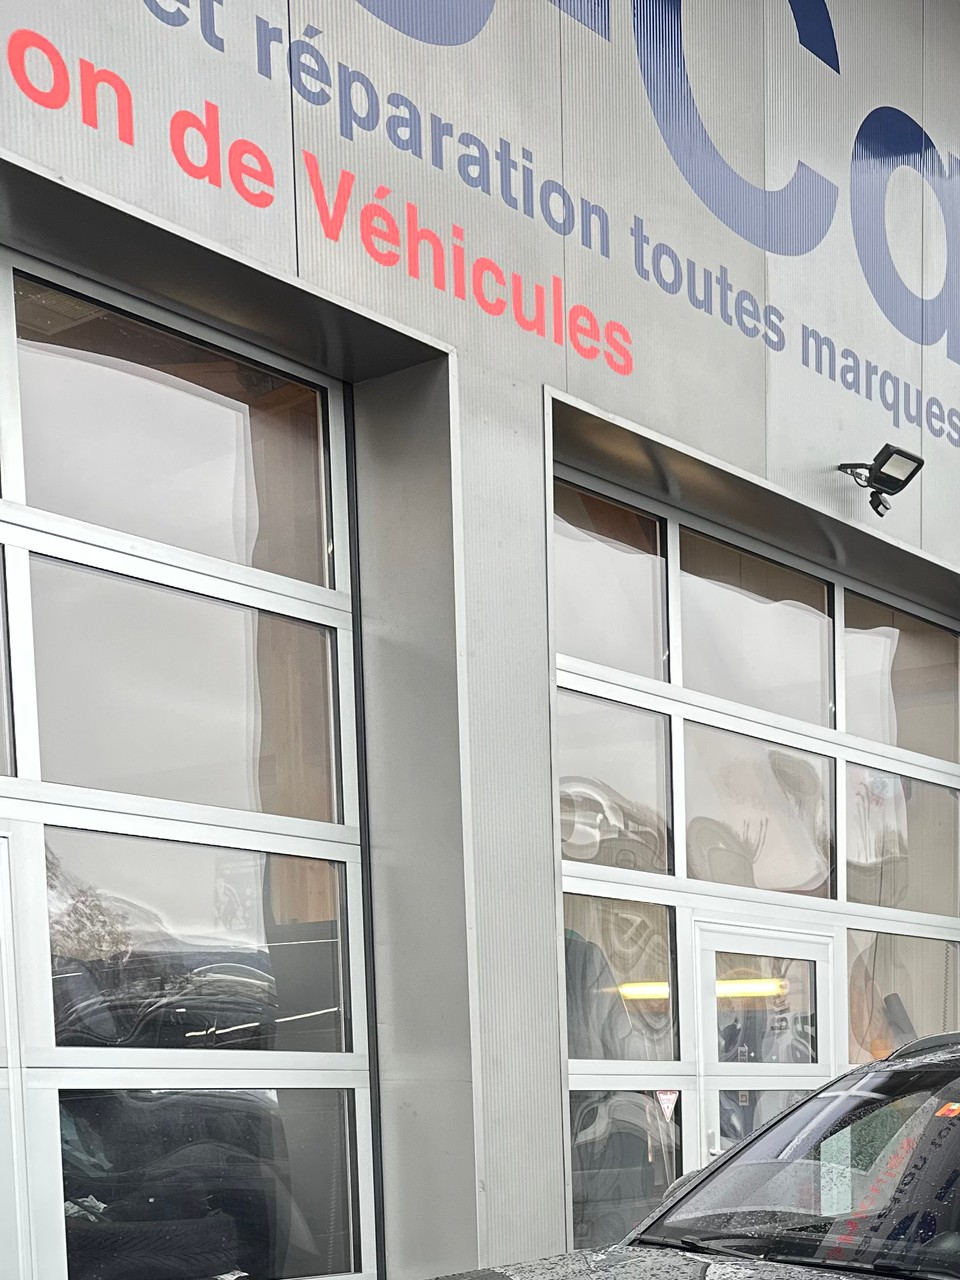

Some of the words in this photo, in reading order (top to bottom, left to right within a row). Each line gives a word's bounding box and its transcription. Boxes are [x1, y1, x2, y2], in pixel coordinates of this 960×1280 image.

[170, 100, 275, 209] de
[302, 150, 634, 377] Véhicules
[257, 15, 611, 259] réparation
[631, 215, 786, 352] toutes
